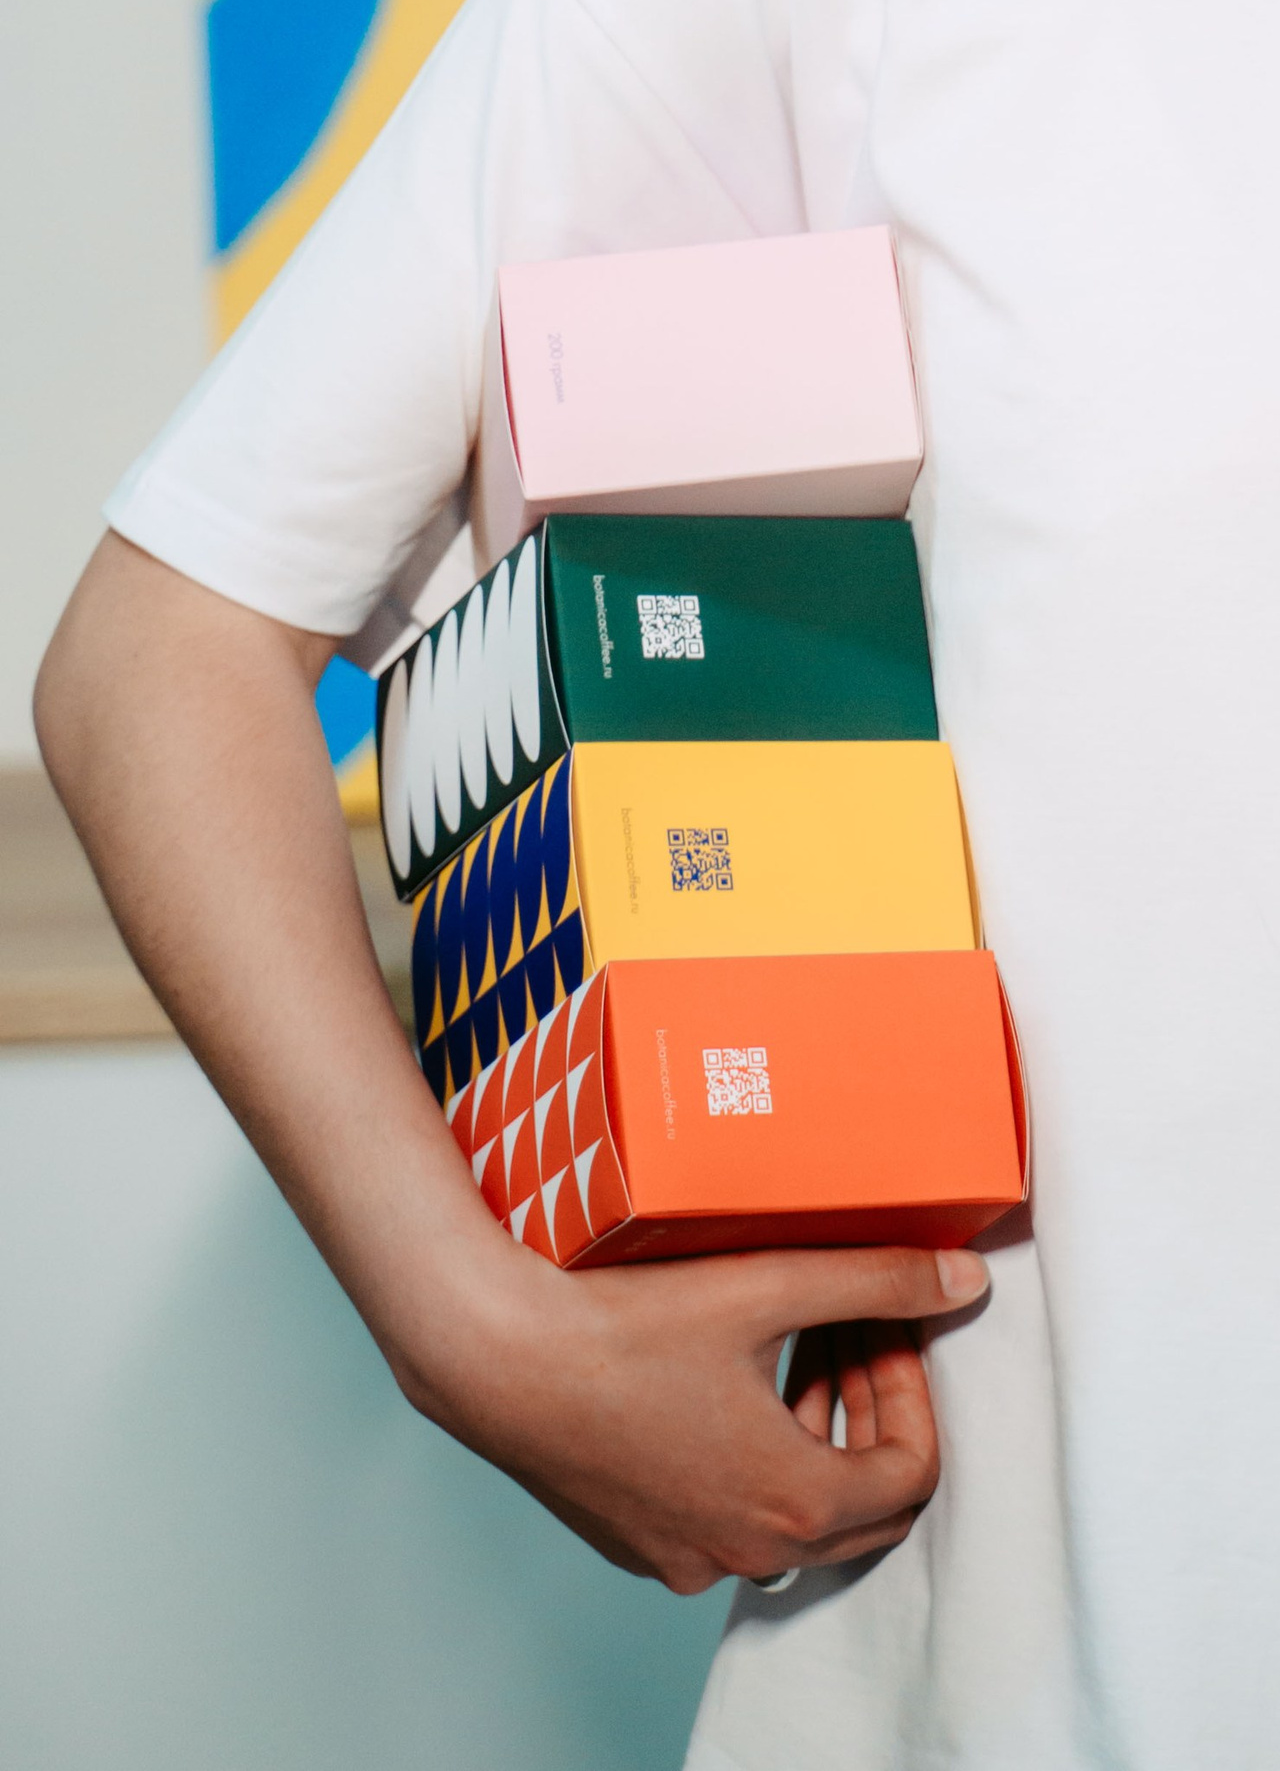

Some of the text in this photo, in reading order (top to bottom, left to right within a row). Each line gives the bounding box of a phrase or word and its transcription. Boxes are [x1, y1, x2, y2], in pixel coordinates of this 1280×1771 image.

[547, 333, 564, 403] 200 грамм
[593, 574, 614, 679] botanicacoffee.ru
[621, 808, 640, 914] botanicacoffee.ru
[656, 1028, 677, 1140] botanicacoffee.ru
